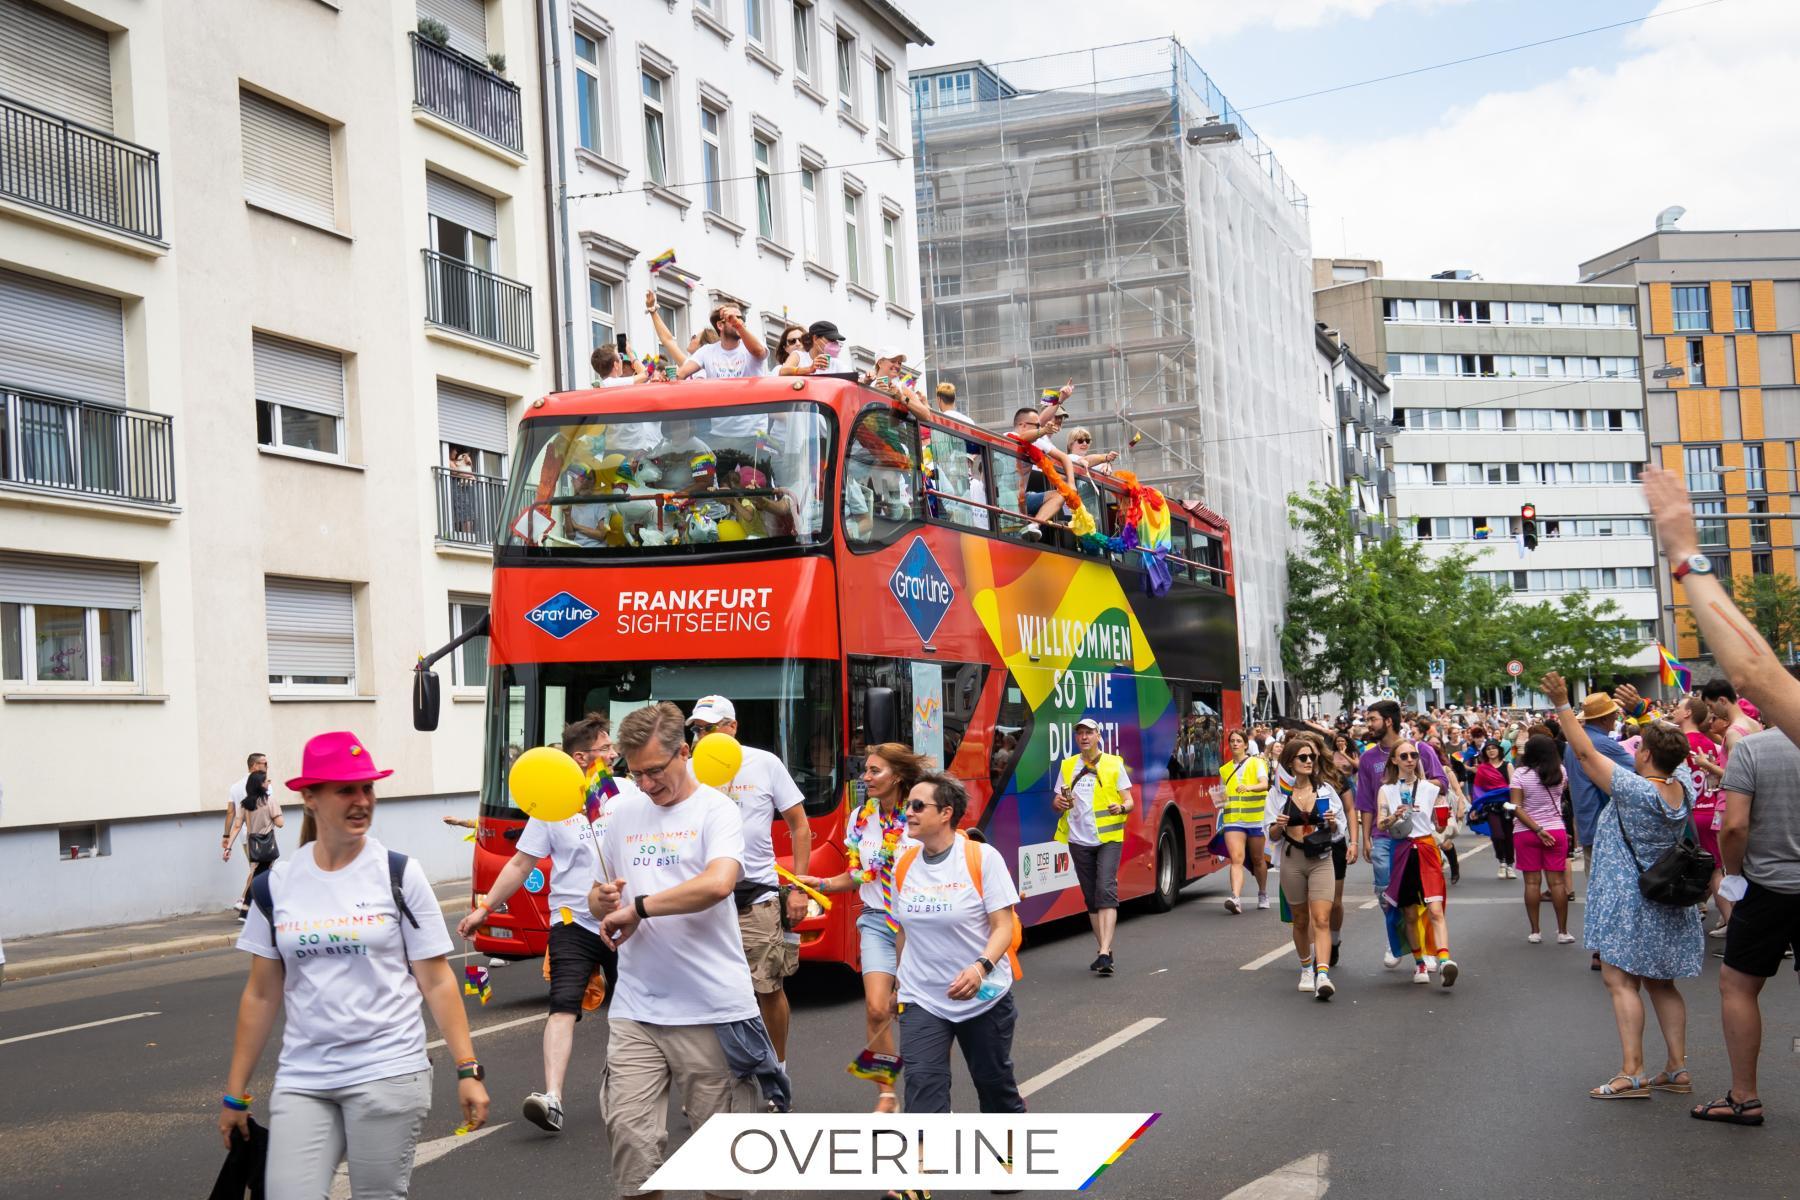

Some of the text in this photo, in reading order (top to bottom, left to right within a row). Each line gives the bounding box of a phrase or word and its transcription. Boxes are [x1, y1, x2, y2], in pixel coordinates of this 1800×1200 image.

[896, 571, 949, 604] Gray Line
[618, 588, 772, 611] FRANKFURT
[531, 608, 593, 622] Gray Line
[617, 612, 771, 634] SIGHTSEEING
[1017, 614, 1131, 660] WILLKOMMEN
[1054, 669, 1113, 709] SO WIE
[1050, 722, 1120, 761] DU ST!
[640, 845, 657, 855] SO
[633, 855, 680, 867] DU BIST!
[912, 895, 926, 903] SO
[907, 904, 953, 913] DU BIST!
[275, 914, 385, 932] WILLKOMMEN
[299, 933, 320, 945] SO
[295, 944, 367, 959] DU BIST!
